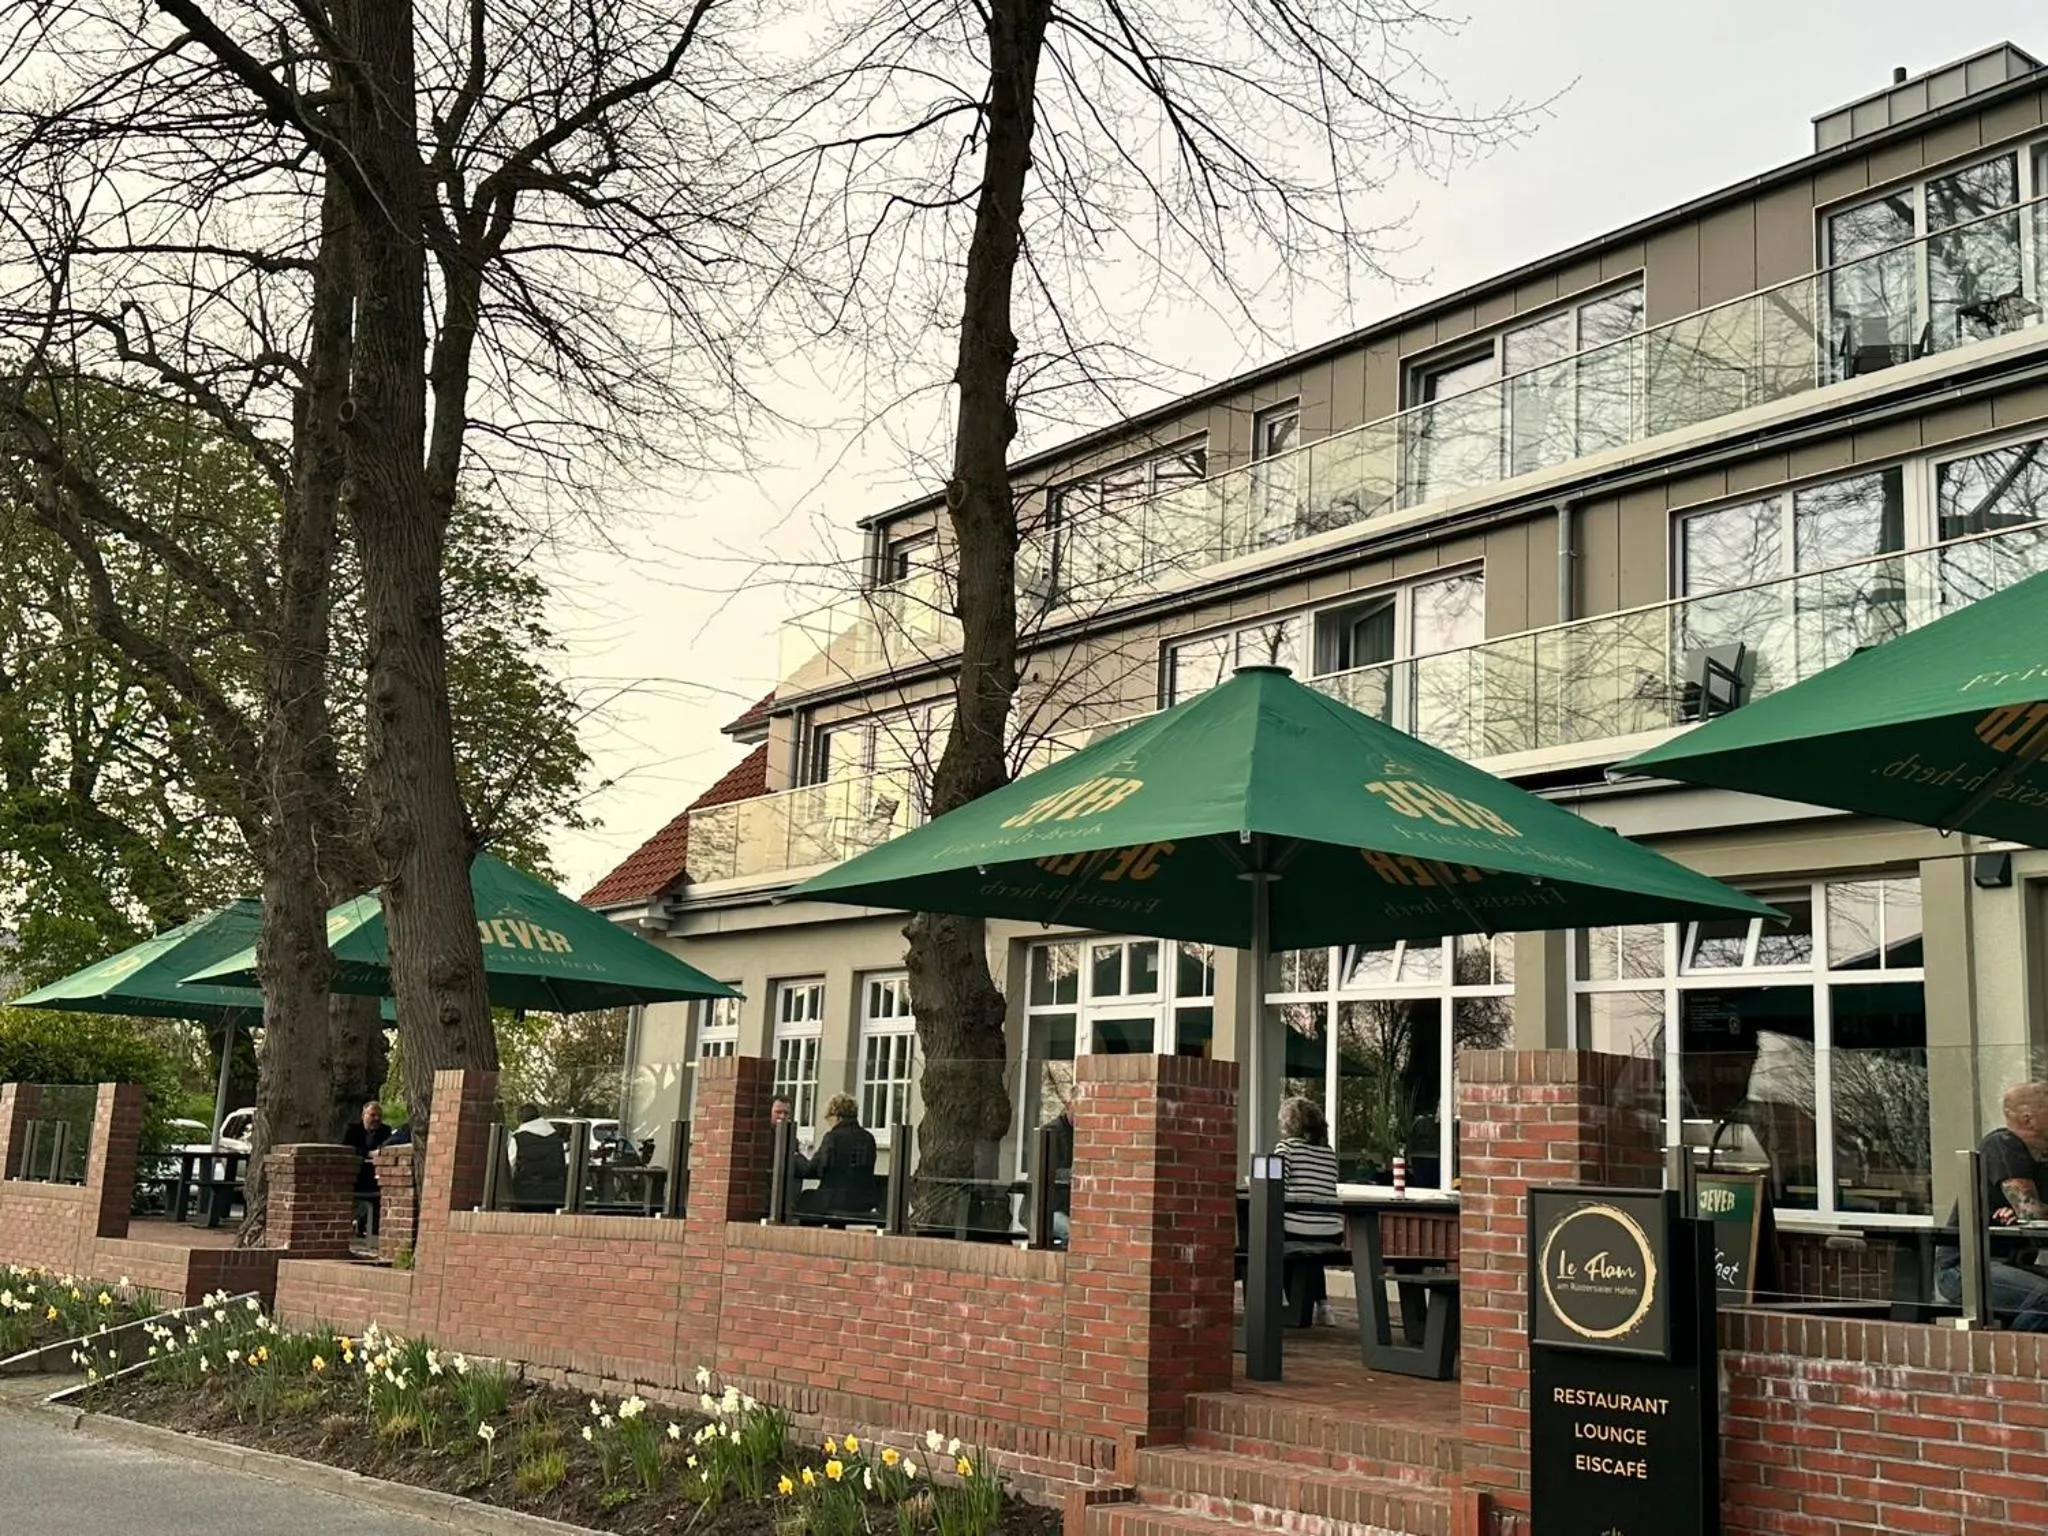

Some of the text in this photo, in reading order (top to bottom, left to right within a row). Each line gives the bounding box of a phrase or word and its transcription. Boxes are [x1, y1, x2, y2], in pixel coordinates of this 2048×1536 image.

[1364, 779, 1524, 838] JEVER
[1699, 1188, 1736, 1213] JEVER
[1556, 1248, 1578, 1279] Le
[1553, 1386, 1669, 1416] RESTAURANT
[1574, 1421, 1648, 1447] LOUNGE
[1575, 1453, 1648, 1480] EISCAFÉ
